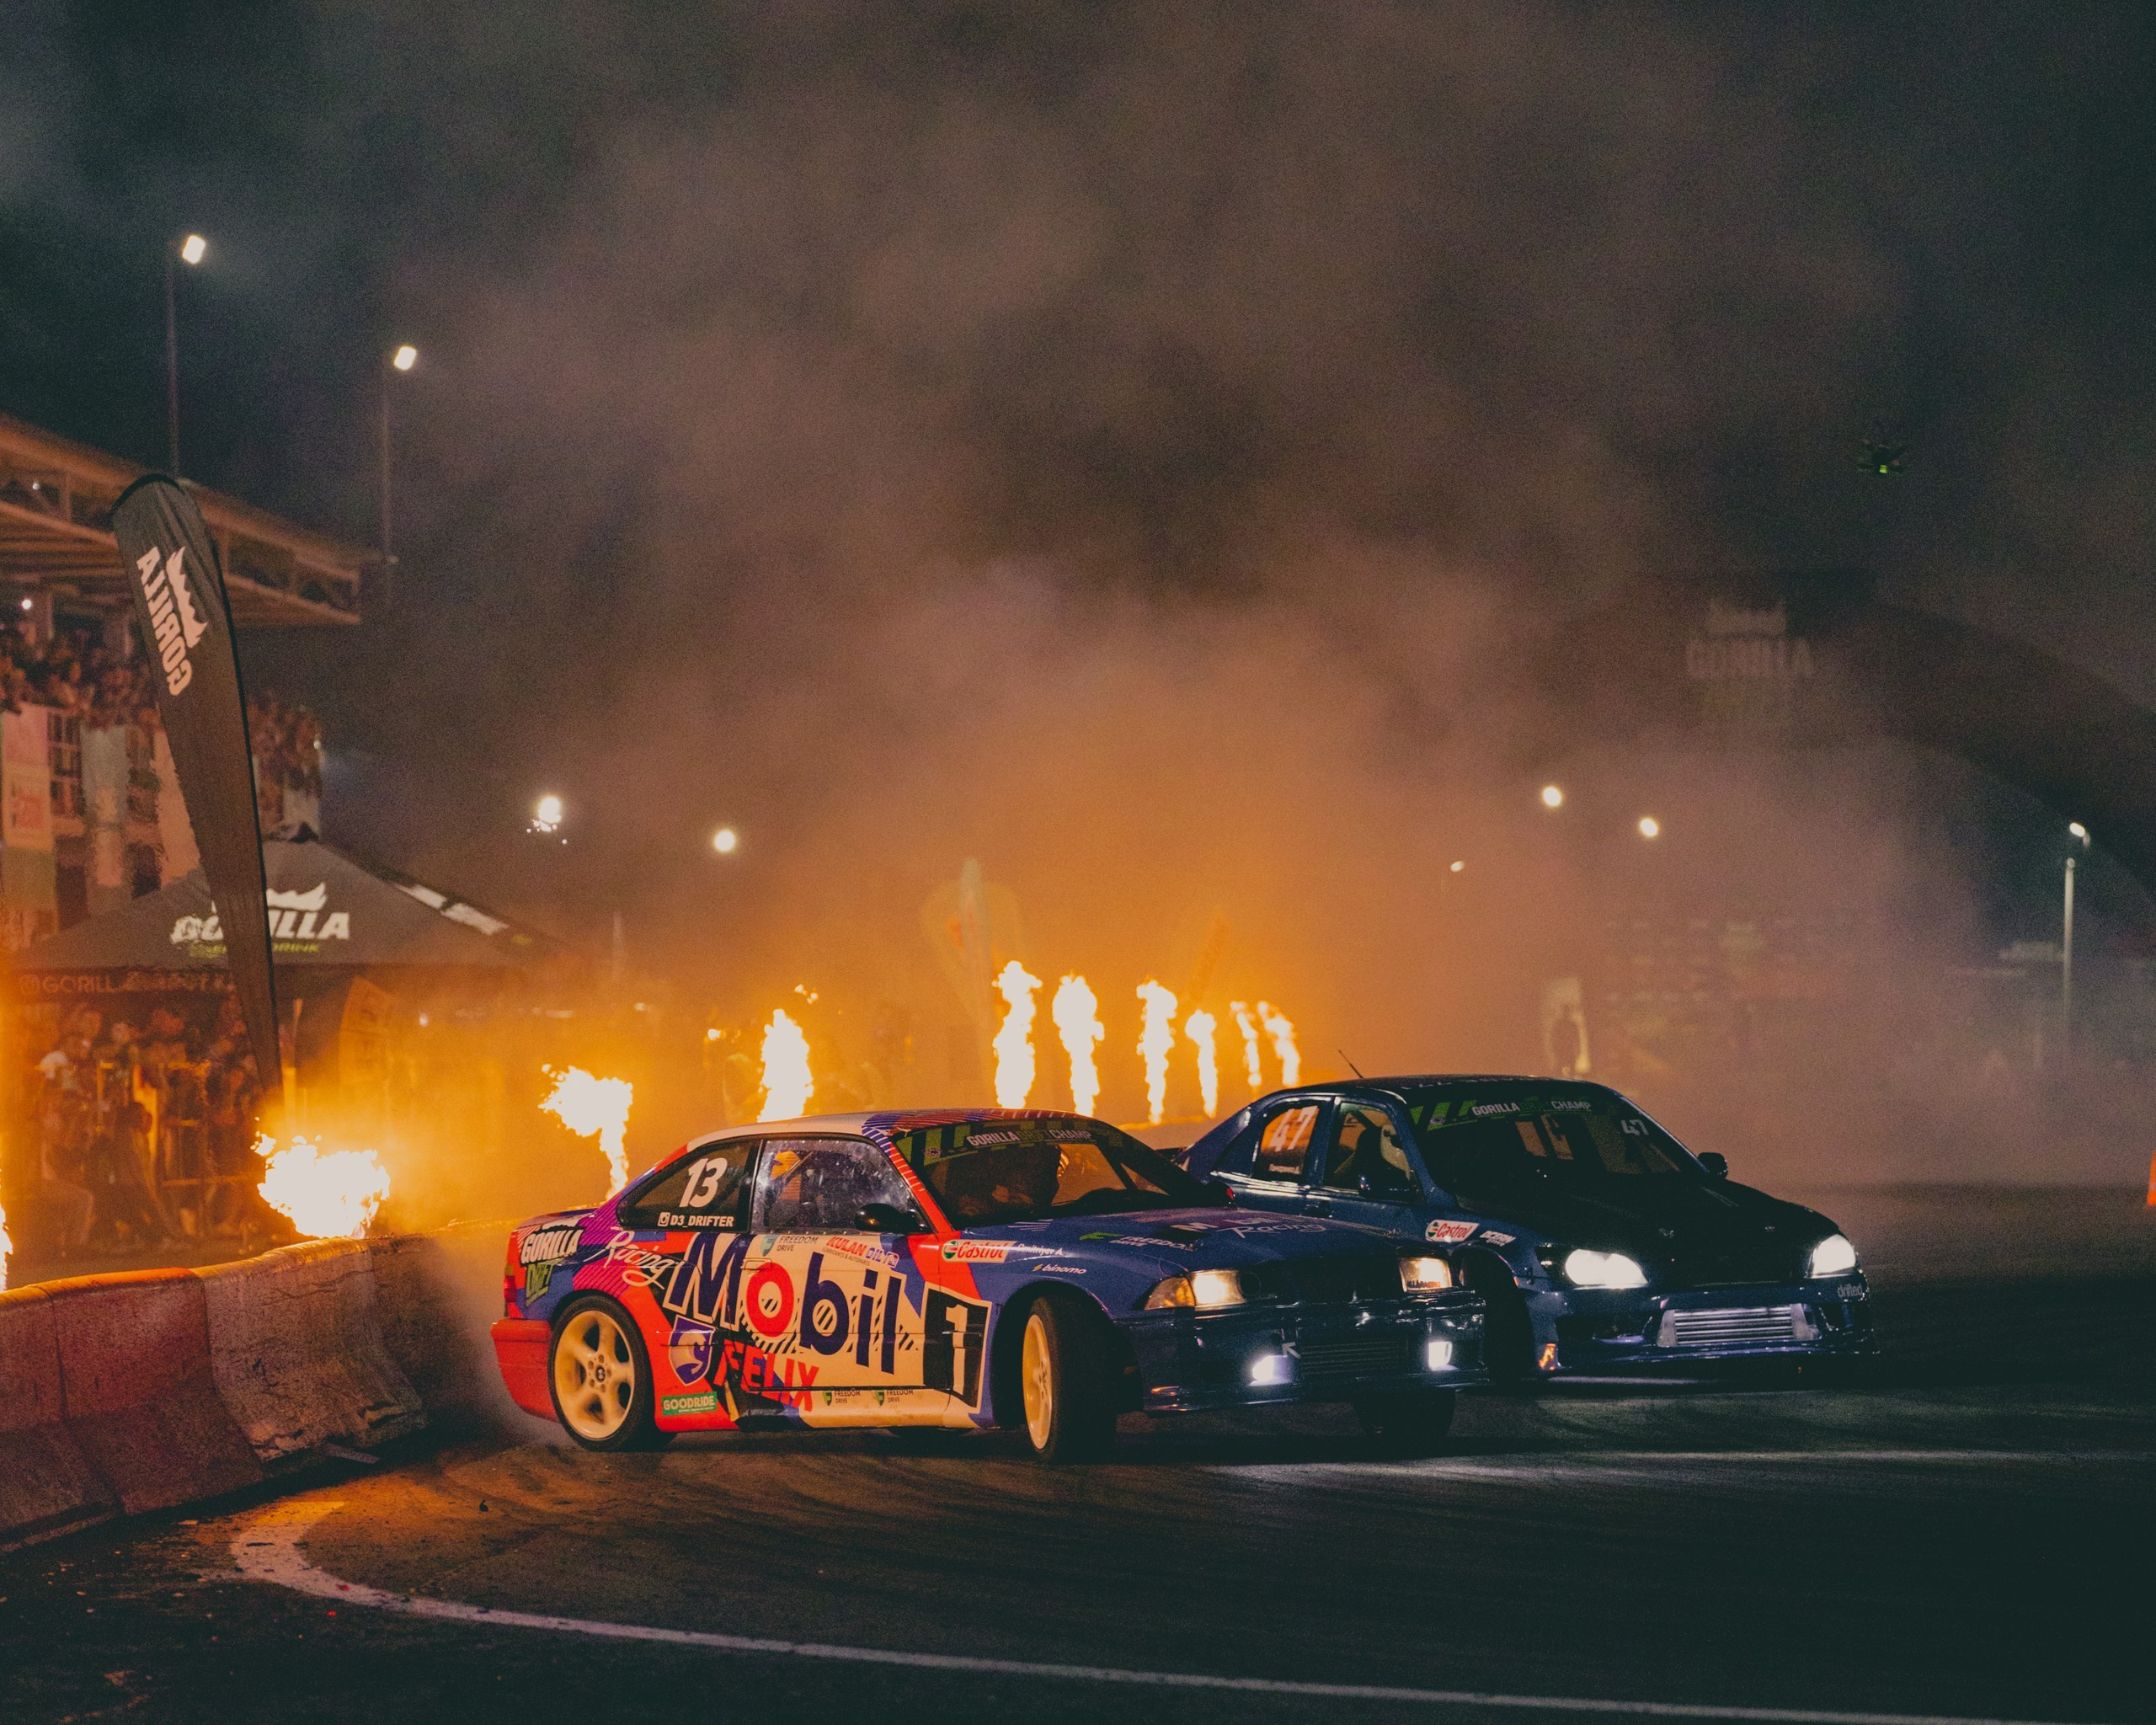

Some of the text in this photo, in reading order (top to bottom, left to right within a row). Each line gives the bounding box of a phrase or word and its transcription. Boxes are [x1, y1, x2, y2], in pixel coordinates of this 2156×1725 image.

[1471, 1101, 1520, 1116] GORILLA
[1550, 1100, 1592, 1111] CHAMP
[1268, 1105, 1319, 1152] 47
[1621, 1118, 1649, 1136] 47
[966, 1130, 1021, 1146] GORILLA
[1049, 1130, 1091, 1139] CHAMP
[679, 1157, 728, 1208] 13
[670, 1215, 734, 1228] D3_DRIFTER
[1216, 1224, 1326, 1239] Racing
[1436, 1223, 1473, 1238] Castrol
[520, 1230, 584, 1263] GORILLA
[779, 1236, 819, 1244] FREEDOM
[826, 1236, 867, 1257] KULAN
[586, 1226, 679, 1290] Racing
[958, 1242, 1007, 1259] Castrol
[1042, 1263, 1087, 1274] binomo
[665, 1233, 968, 1396] Mobil 1
[713, 1339, 820, 1413] FELIX
[886, 1389, 914, 1397] FREEDOM
[663, 1395, 715, 1411] GOODRIDE
